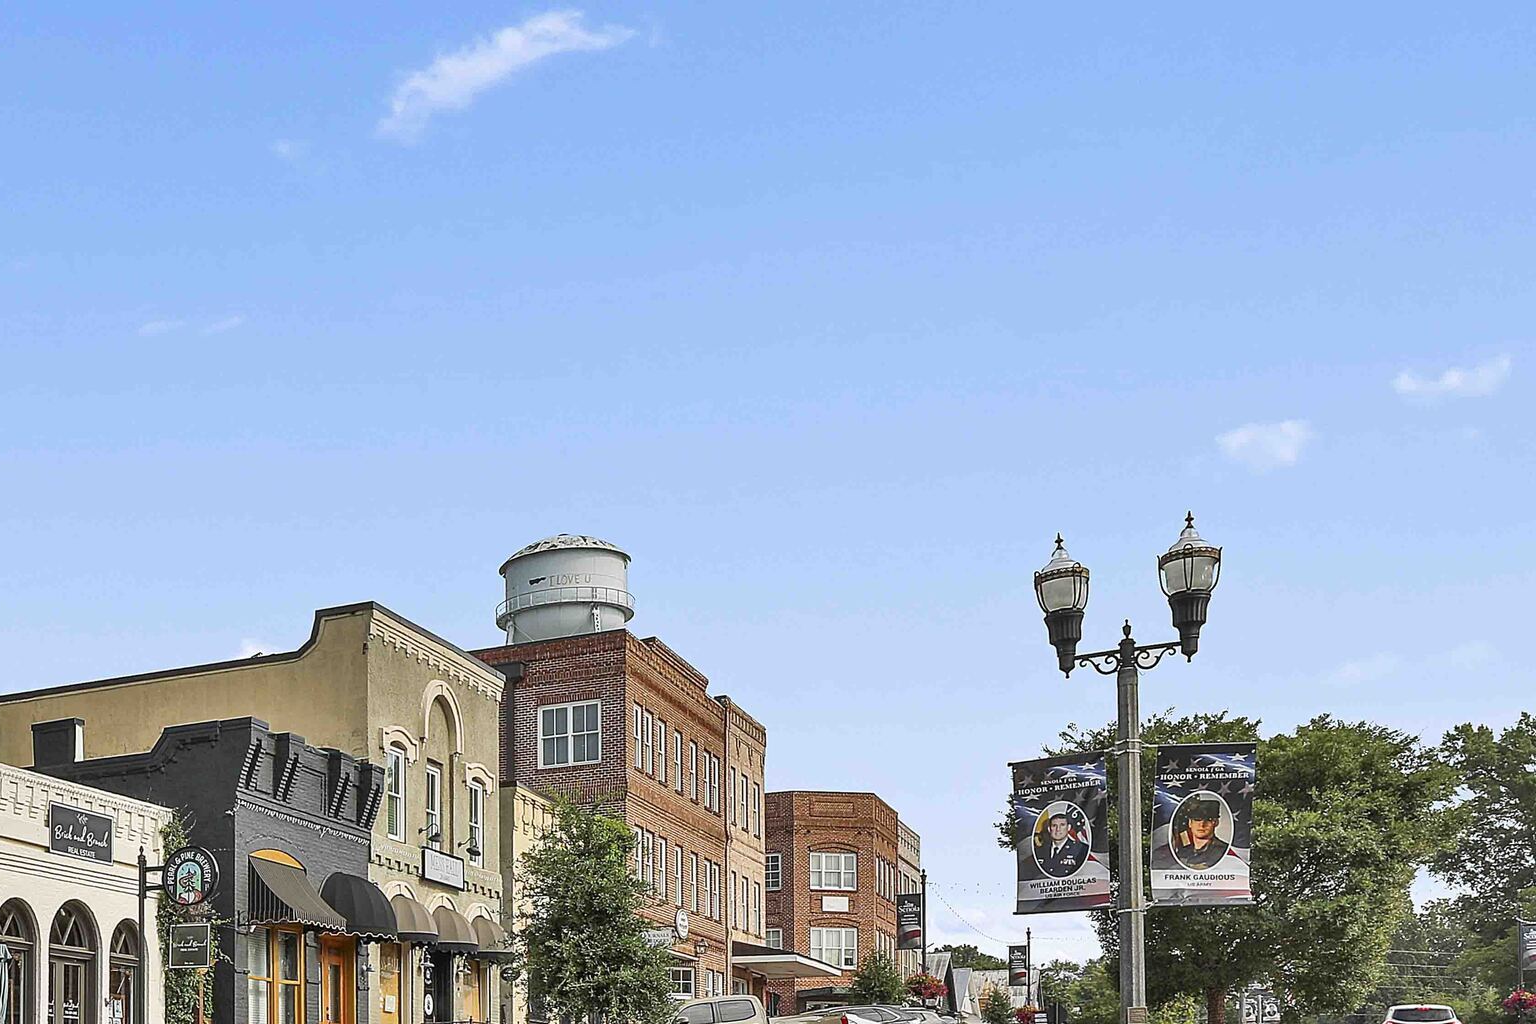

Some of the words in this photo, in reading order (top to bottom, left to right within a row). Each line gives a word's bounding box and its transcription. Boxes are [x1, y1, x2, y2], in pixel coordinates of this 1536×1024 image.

[549, 575, 555, 587] I
[556, 573, 580, 586] LOVE
[584, 573, 591, 584] U
[1040, 778, 1063, 786] SENOIA
[1199, 772, 1250, 780] REMEMBER
[1017, 785, 1049, 796] HONOR
[1054, 779, 1101, 791] REMEMBER
[54, 824, 73, 841] Brick
[73, 825, 87, 843] and
[67, 846, 80, 856] REAL
[79, 848, 96, 859] ESTATE
[167, 863, 178, 885] PEARL
[174, 856, 182, 865] &
[180, 851, 195, 861] PINE
[195, 853, 212, 882] BREWERY
[1030, 880, 1061, 889] WILLIAM
[1061, 877, 1097, 886] DOUGLAS
[1039, 885, 1073, 894] BEARDEN
